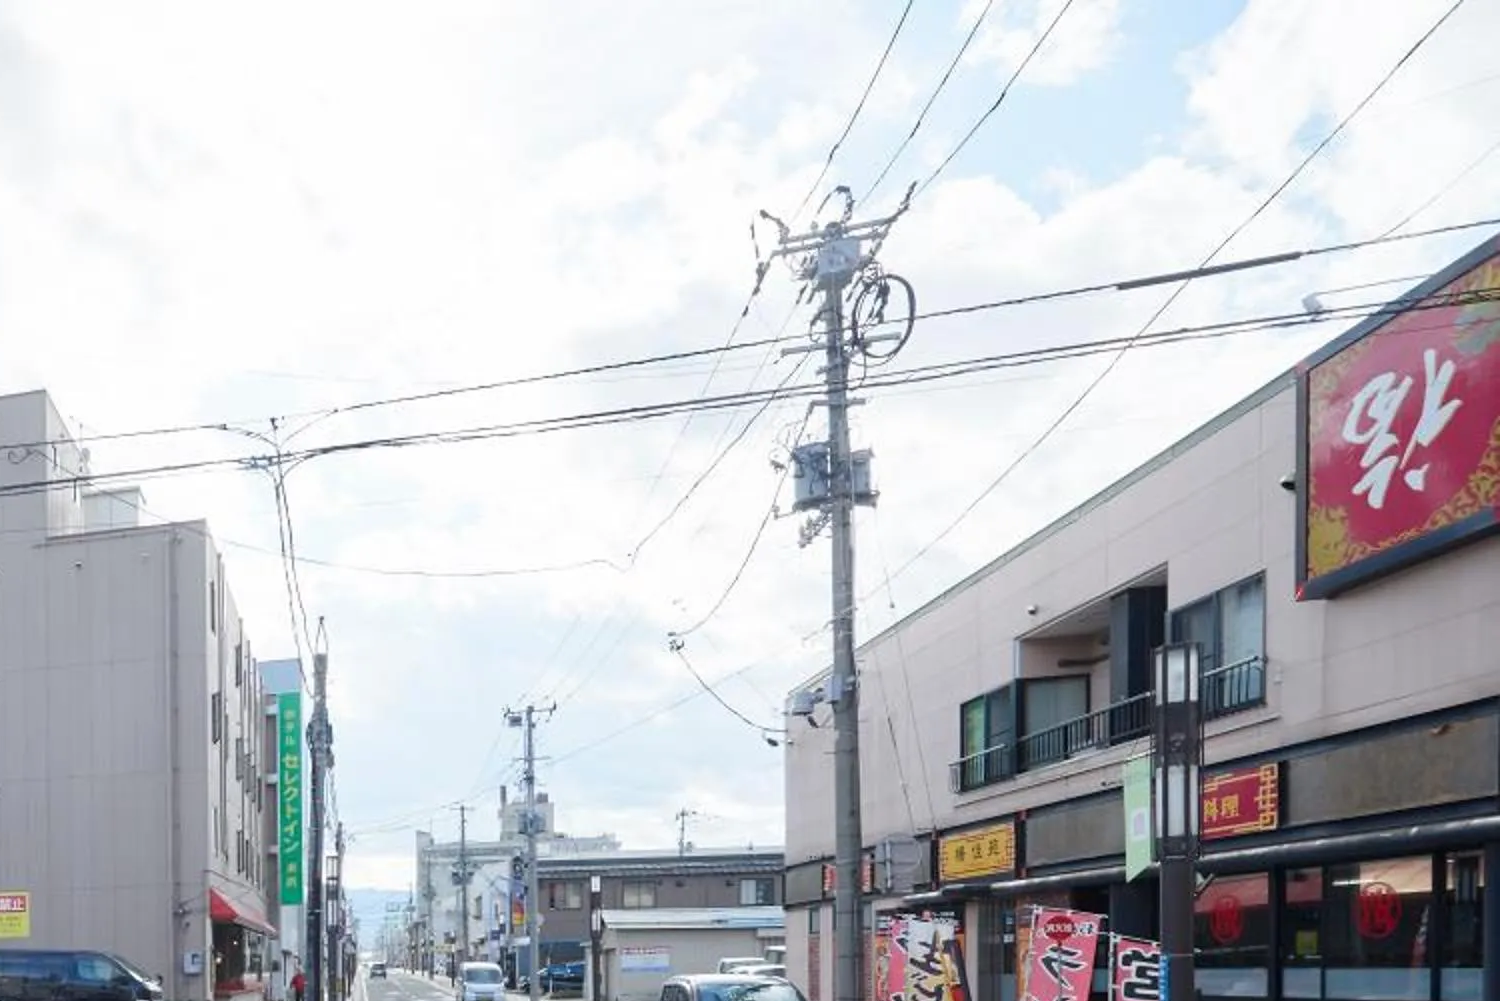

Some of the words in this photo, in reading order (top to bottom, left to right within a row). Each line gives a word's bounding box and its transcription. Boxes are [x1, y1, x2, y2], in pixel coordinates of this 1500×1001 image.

[282, 752, 300, 854] セレクトイン
